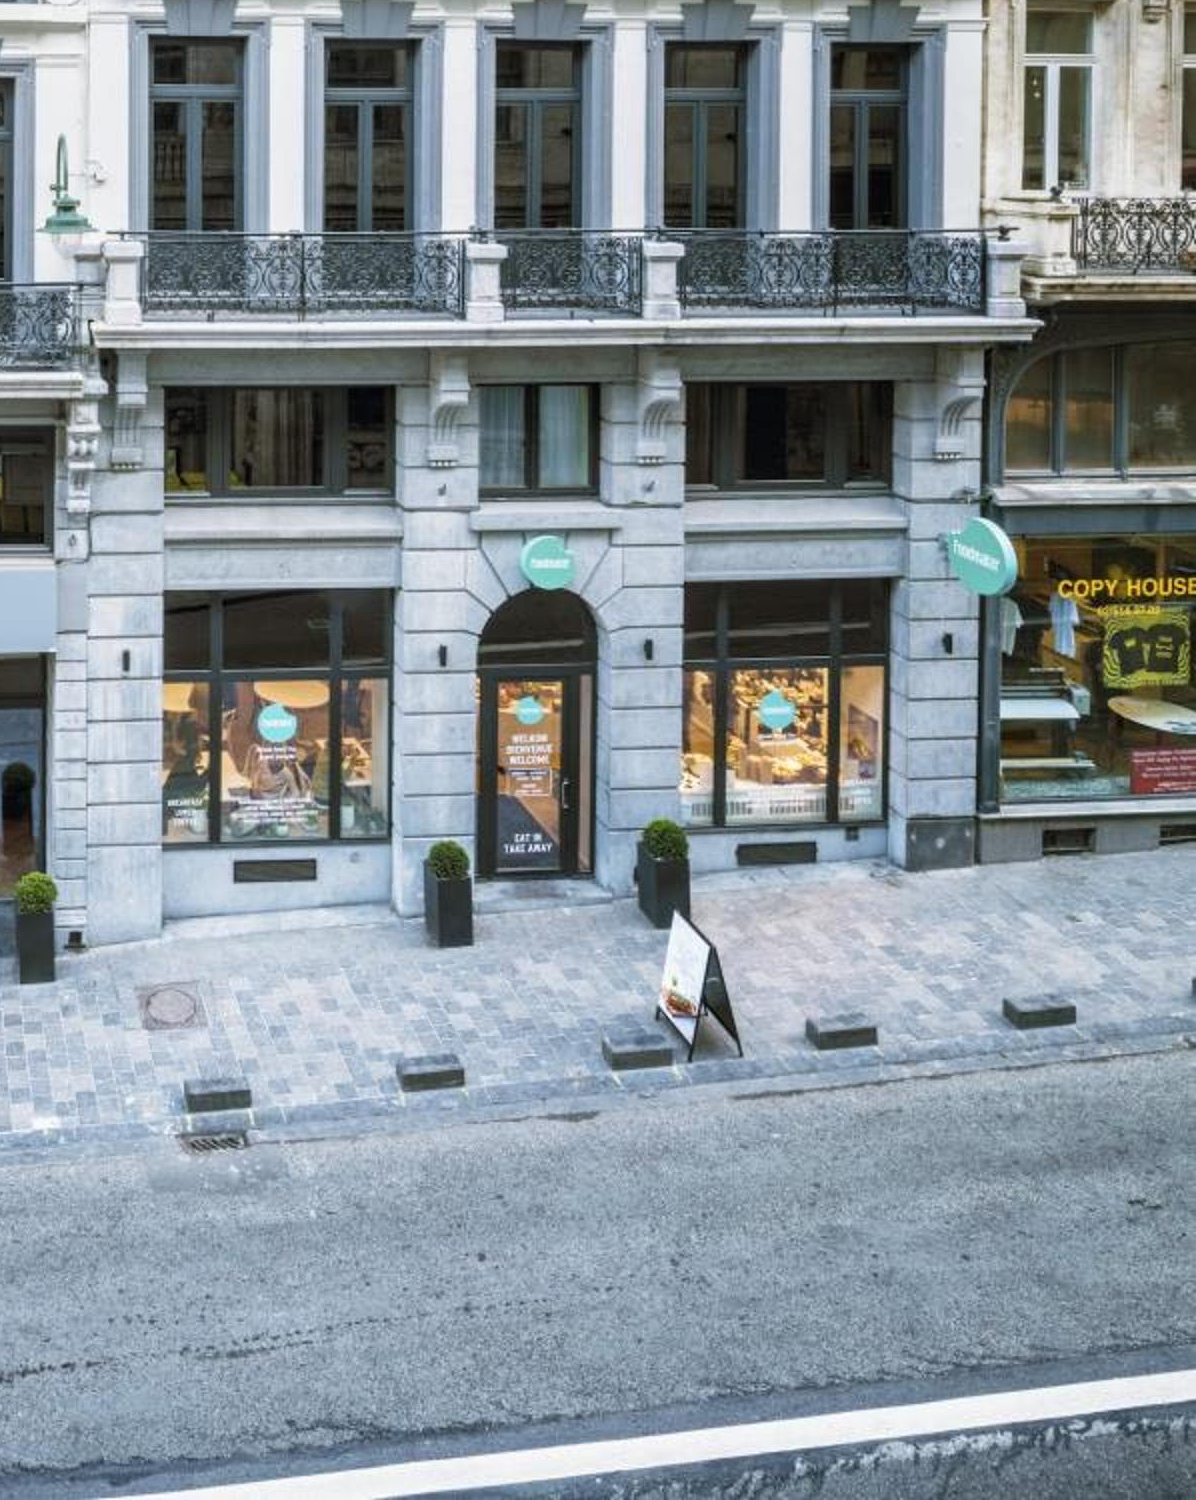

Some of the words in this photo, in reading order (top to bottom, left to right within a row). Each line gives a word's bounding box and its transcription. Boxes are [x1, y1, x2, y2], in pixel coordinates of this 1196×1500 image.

[1058, 579, 1118, 598] COPY
[1126, 577, 1196, 597] HOUSE
[514, 833, 531, 843] EAT
[503, 843, 526, 853] TAKE
[527, 842, 553, 853] AWAY
